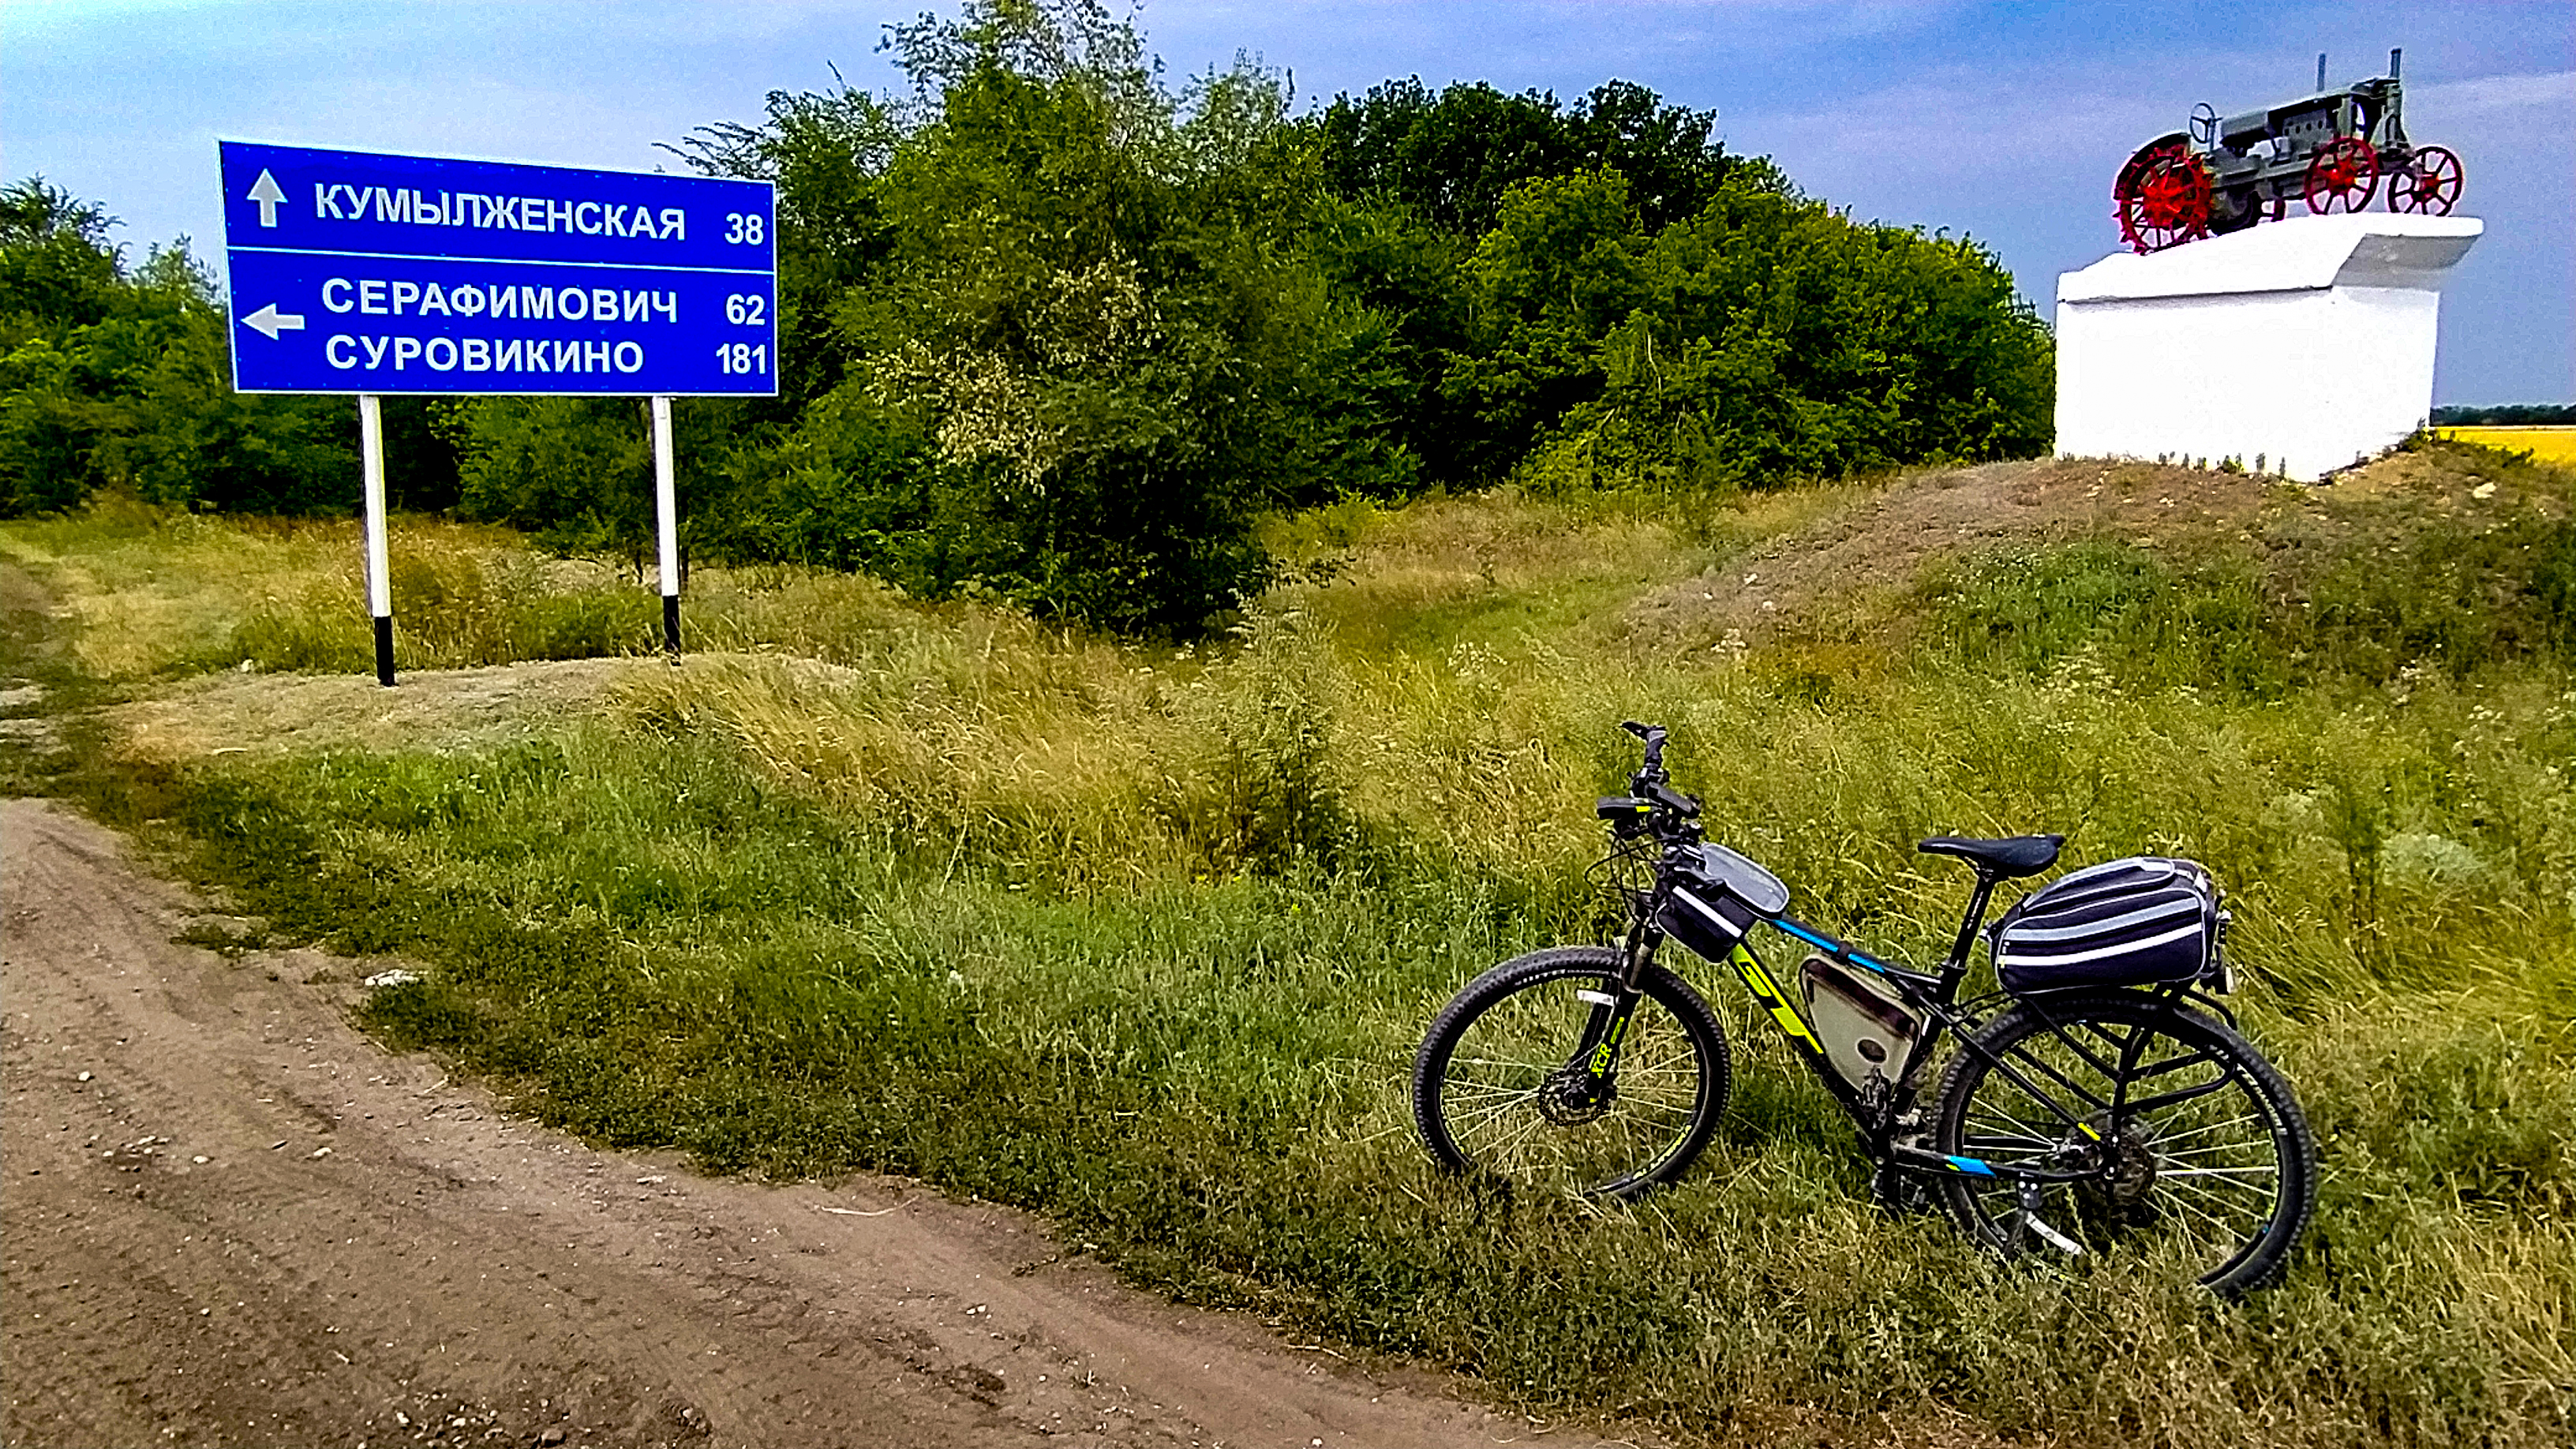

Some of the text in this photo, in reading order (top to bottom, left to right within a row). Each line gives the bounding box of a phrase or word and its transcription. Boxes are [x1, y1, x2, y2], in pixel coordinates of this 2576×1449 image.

[315, 183, 764, 245] КУМЫЛЖЕНСКАЯ 38
[322, 278, 765, 326] СЕРАФИМОВИЧ 62
[326, 335, 766, 374] СУРОВИКИНО 181
[1732, 944, 1824, 1054] GT
[1591, 1043, 1612, 1078] XCR
